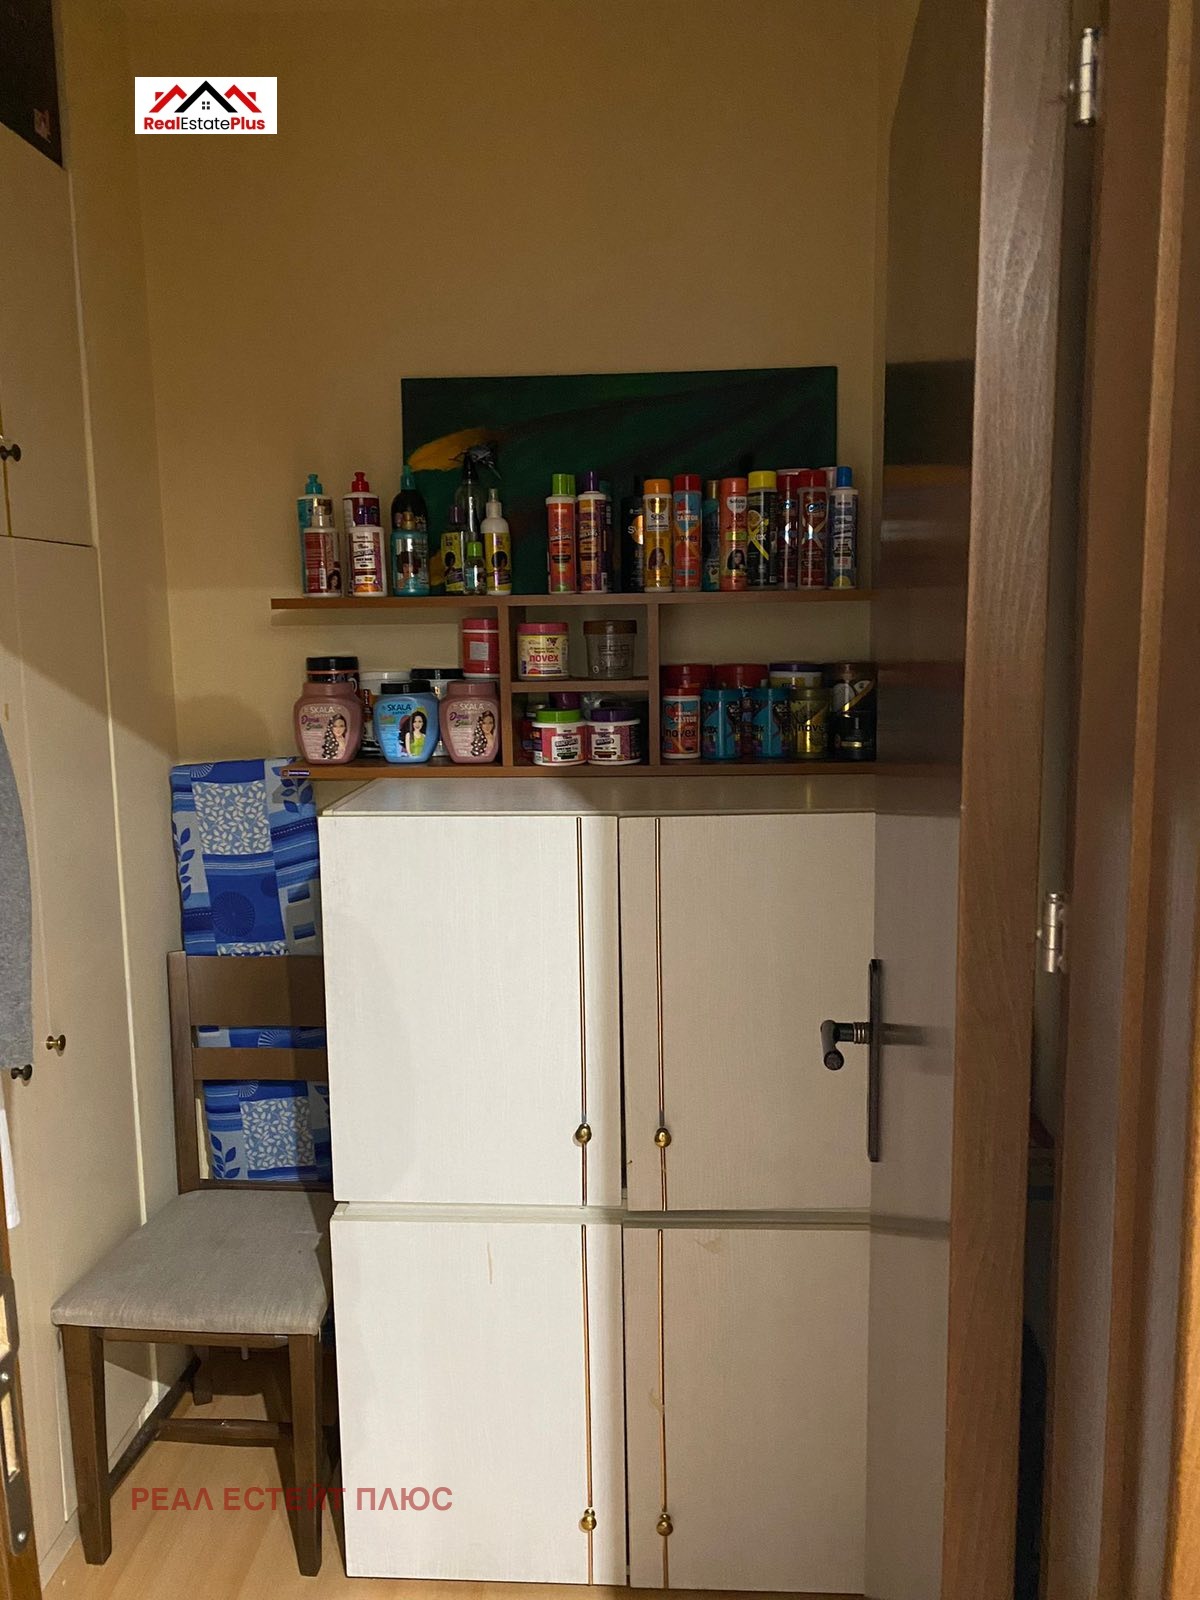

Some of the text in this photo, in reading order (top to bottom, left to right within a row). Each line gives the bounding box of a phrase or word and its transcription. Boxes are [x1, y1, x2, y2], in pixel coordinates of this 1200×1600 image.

[529, 653, 559, 662] novex
[310, 706, 336, 714] SKALA
[387, 703, 412, 712] SKALA
[459, 703, 485, 711] SKALA
[665, 728, 697, 738] novex
